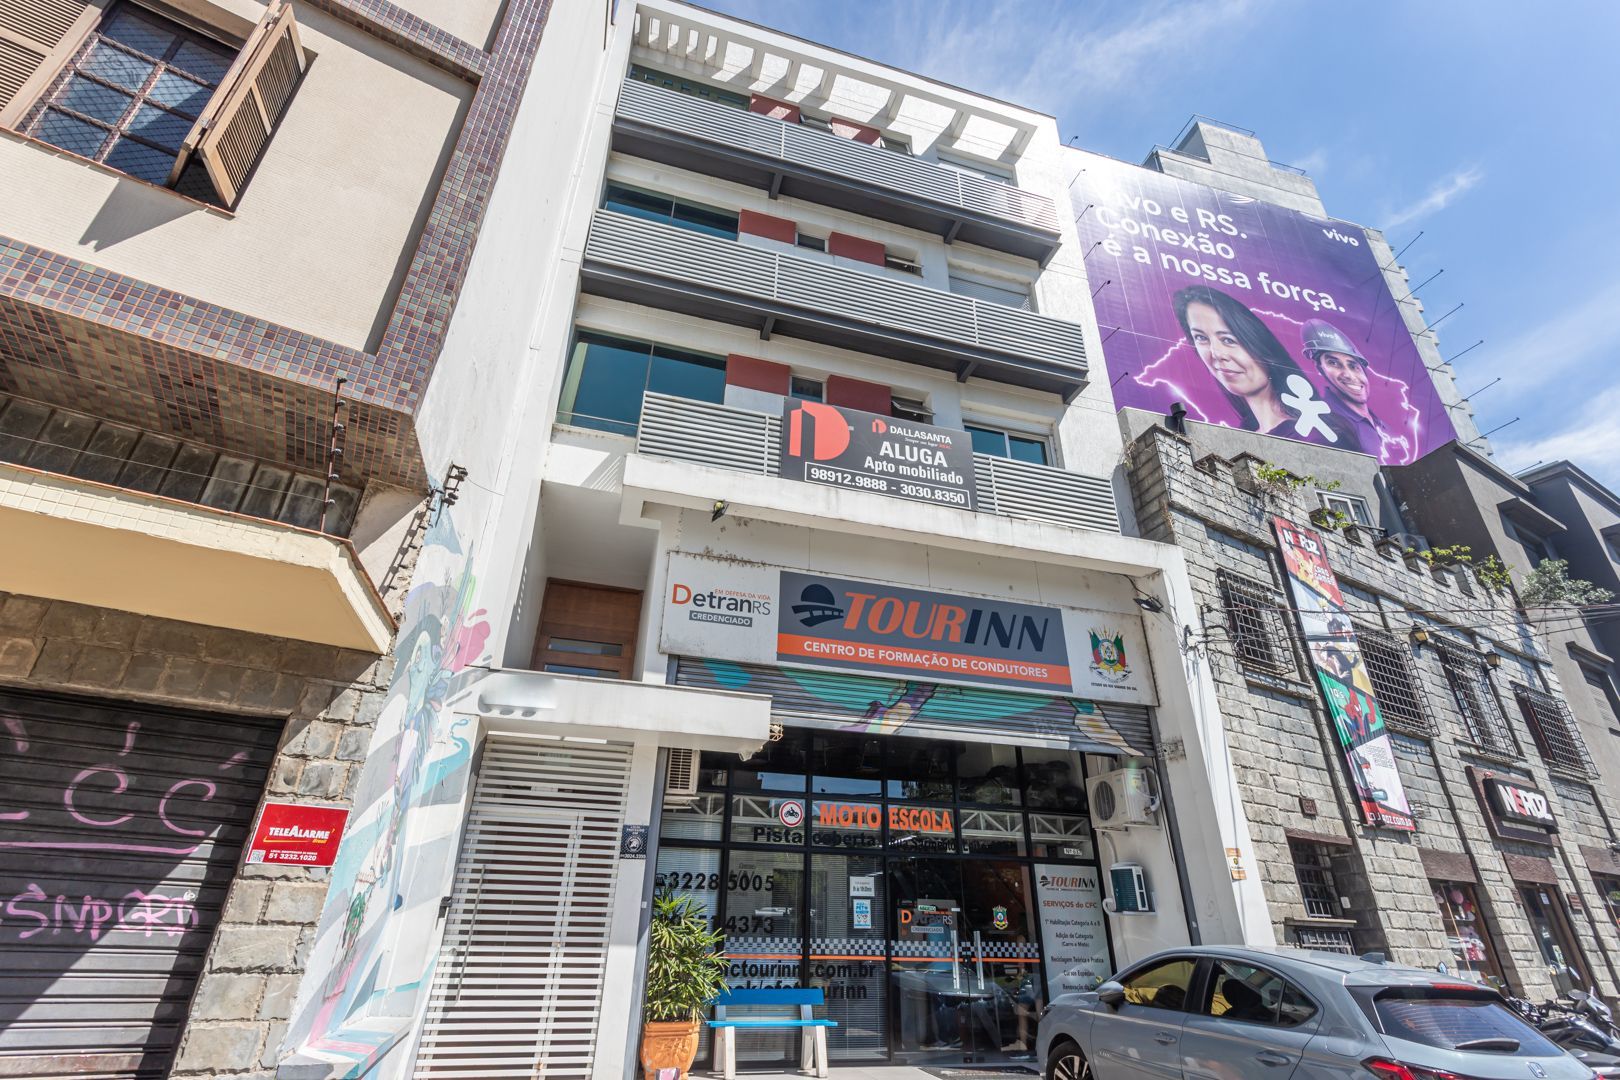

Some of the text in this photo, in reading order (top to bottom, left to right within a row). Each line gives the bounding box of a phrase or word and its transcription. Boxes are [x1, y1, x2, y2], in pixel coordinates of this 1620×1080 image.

[1096, 205, 1235, 260] Conexão
[1170, 205, 1189, 223] e
[1196, 207, 1248, 240] RS.
[1322, 227, 1360, 248] vivo
[1103, 233, 1346, 313] é a nossa força.
[890, 425, 952, 446] DALLASANTA
[879, 440, 949, 468] ALUGA
[864, 455, 964, 486] Apto mobiliado
[810, 467, 888, 491] 98912.9888
[900, 483, 965, 504] 3030.8350
[671, 583, 771, 616] DetranRS
[725, 589, 748, 599] DEFESA
[691, 612, 751, 626] CREDENCIADO
[843, 591, 1049, 652] TOURINN
[803, 641, 1048, 678] CENTRO DE FORMAÇÃO DE CONDUTORES
[819, 803, 953, 832] MOTO ESCOLA
[753, 826, 802, 844] Pista
[279, 853, 317, 861] 3232.1020
[668, 872, 775, 892] 3228 5005
[1050, 876, 1096, 888] TOURINN
[1043, 900, 1074, 910] SERVIÇOS
